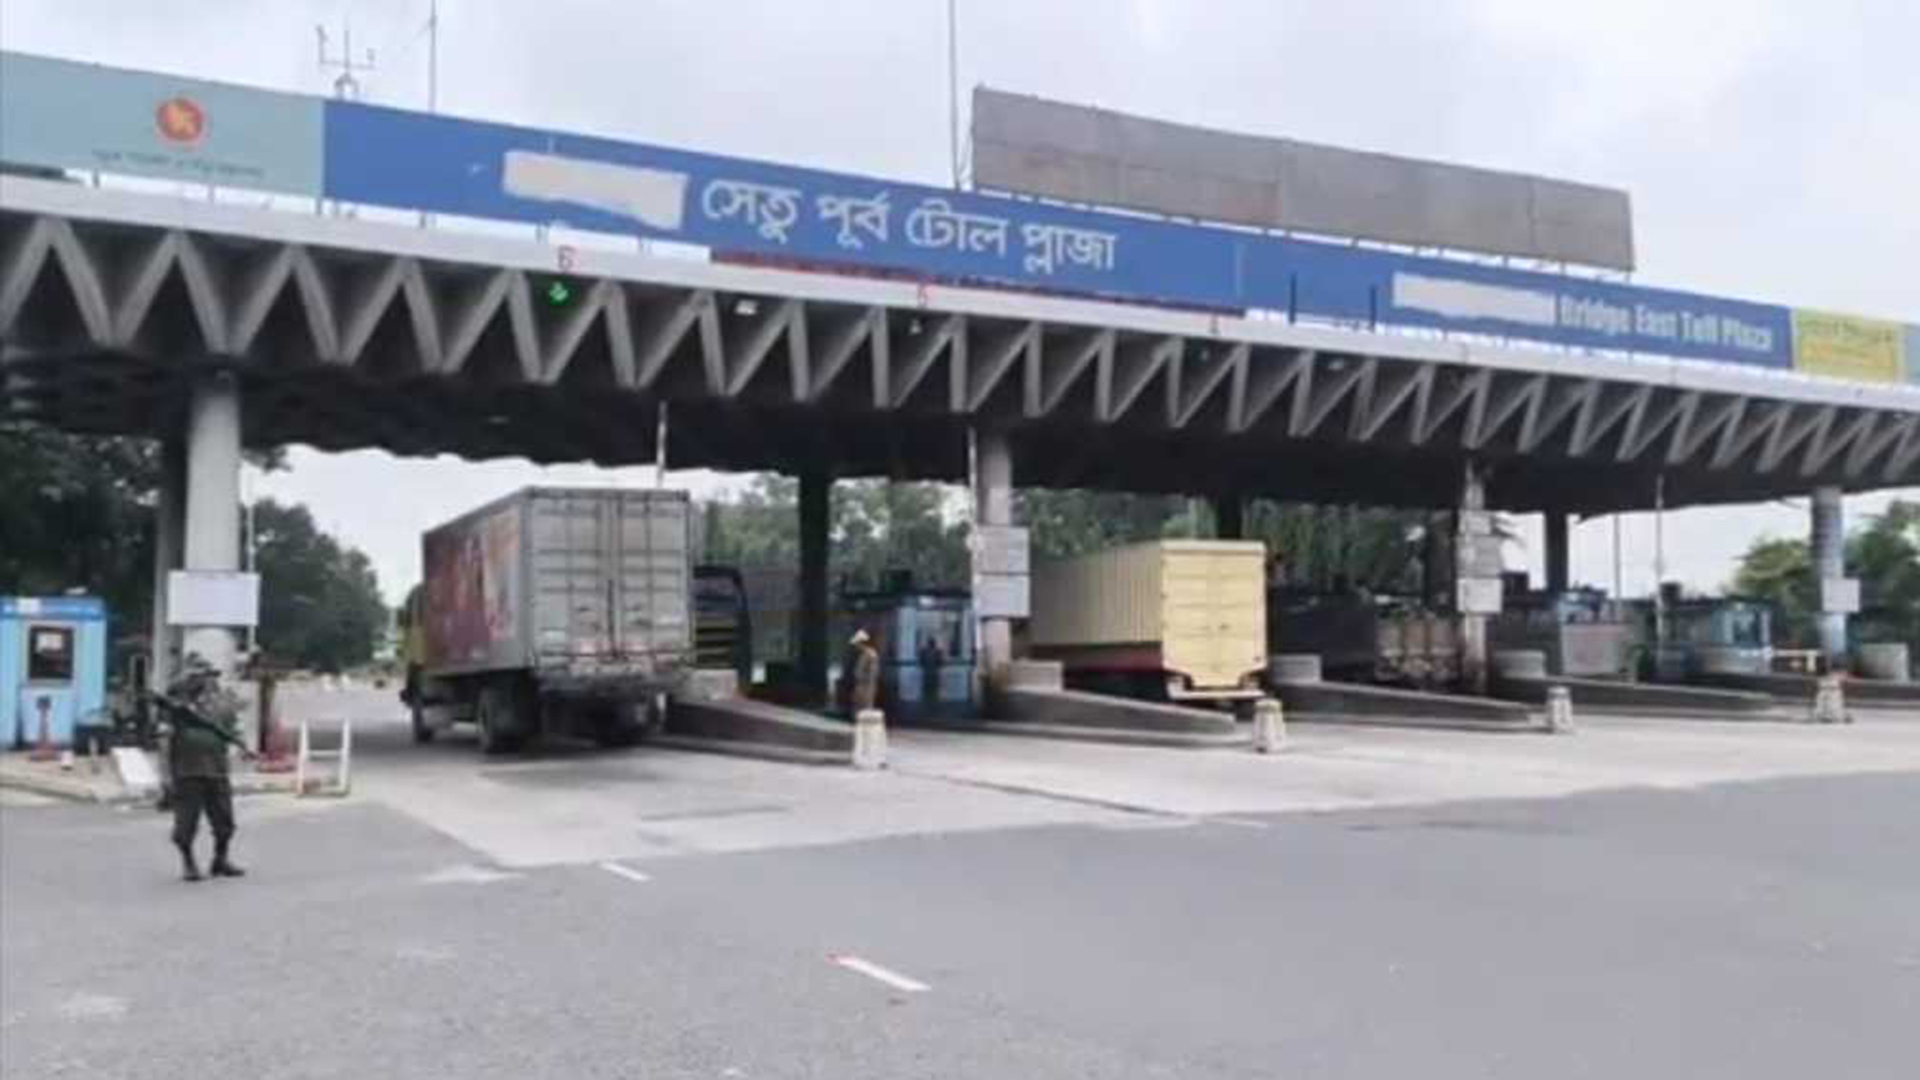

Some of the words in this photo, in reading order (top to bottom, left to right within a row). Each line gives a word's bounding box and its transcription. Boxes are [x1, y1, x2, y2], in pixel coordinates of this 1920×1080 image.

[702, 179, 799, 245] সেতু
[817, 190, 889, 249] পূর্ব
[905, 199, 1007, 256] টোল
[1021, 222, 1118, 275] প্লাজা
[1560, 296, 1631, 337] Bridge
[1634, 304, 1678, 338] East
[1681, 311, 1720, 345] Toll
[1721, 315, 1773, 353] Plaza
